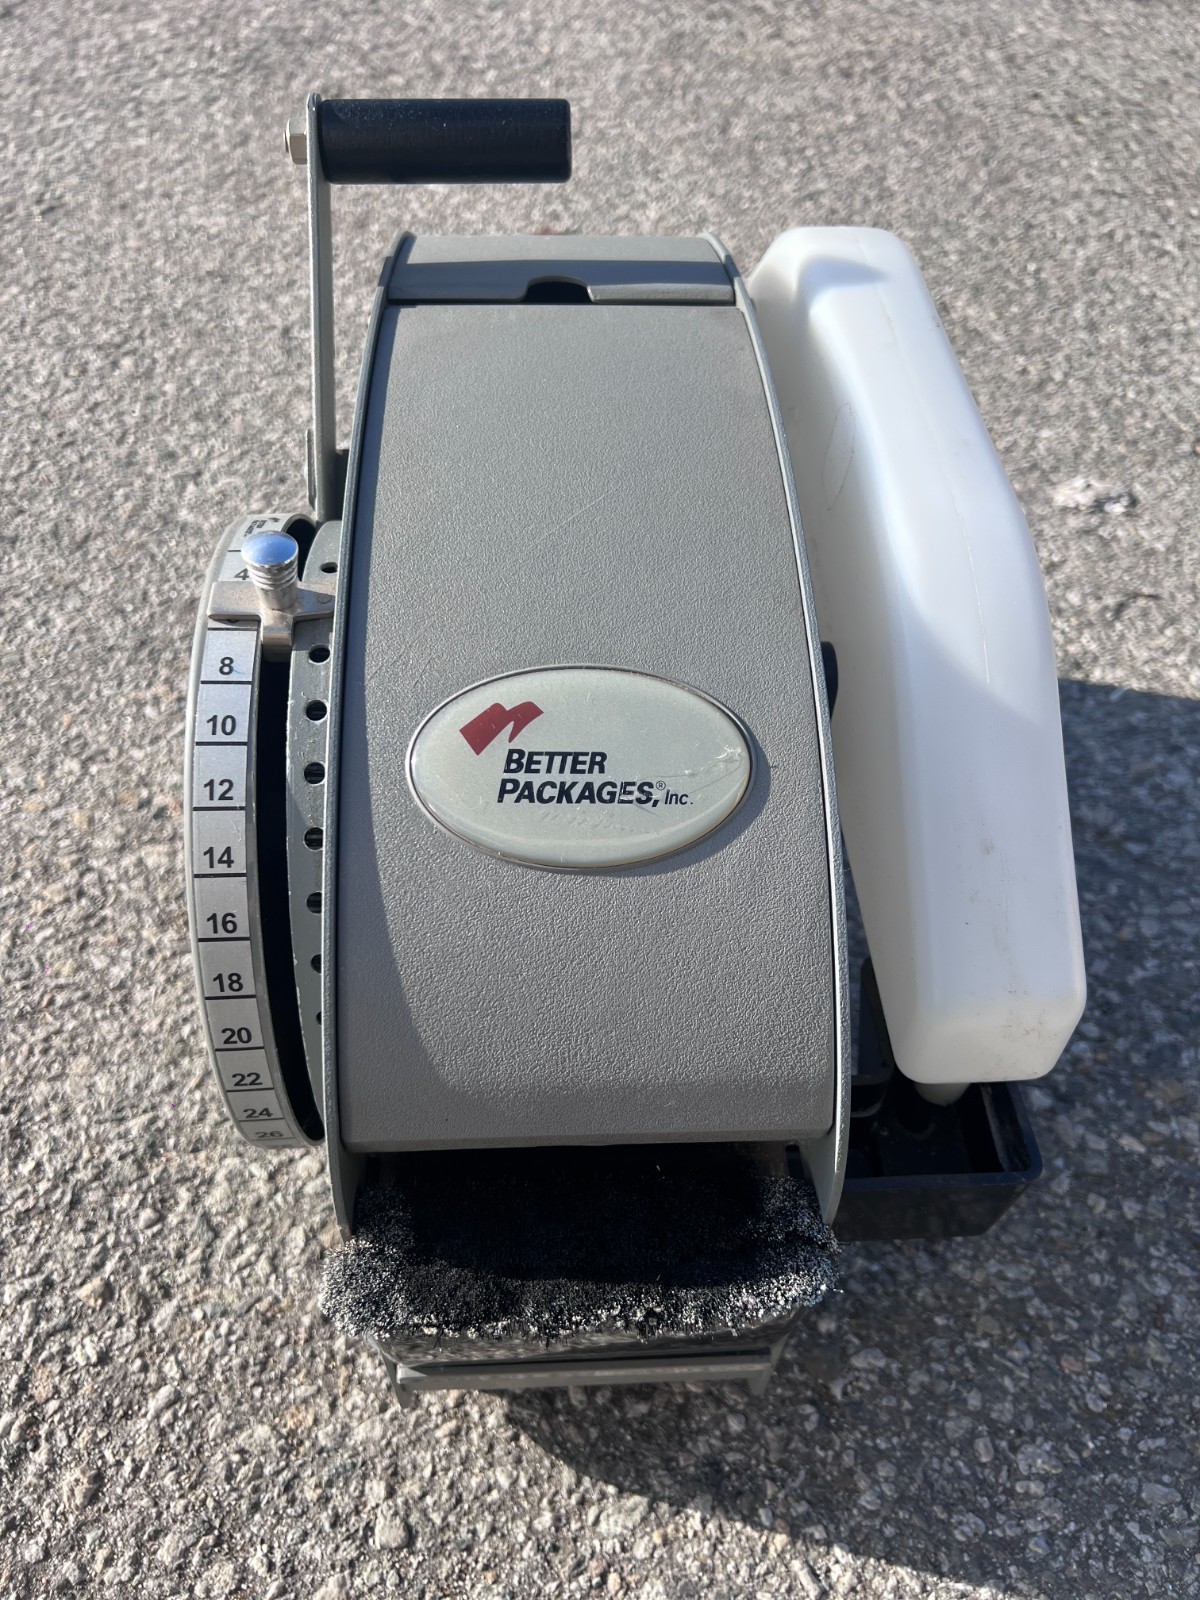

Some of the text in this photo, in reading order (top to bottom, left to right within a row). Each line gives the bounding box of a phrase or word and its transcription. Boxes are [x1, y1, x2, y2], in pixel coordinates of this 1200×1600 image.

[234, 568, 249, 581] 4
[219, 657, 234, 675] 8
[206, 714, 237, 736] 10
[503, 748, 607, 774] BETTER
[203, 778, 234, 801] 12
[665, 789, 694, 805] Inc.
[203, 846, 234, 869] 14
[206, 912, 238, 934] 16
[212, 972, 244, 993] 18
[221, 1027, 252, 1045] 20
[231, 1072, 263, 1087] 22
[243, 1107, 273, 1118] 24
